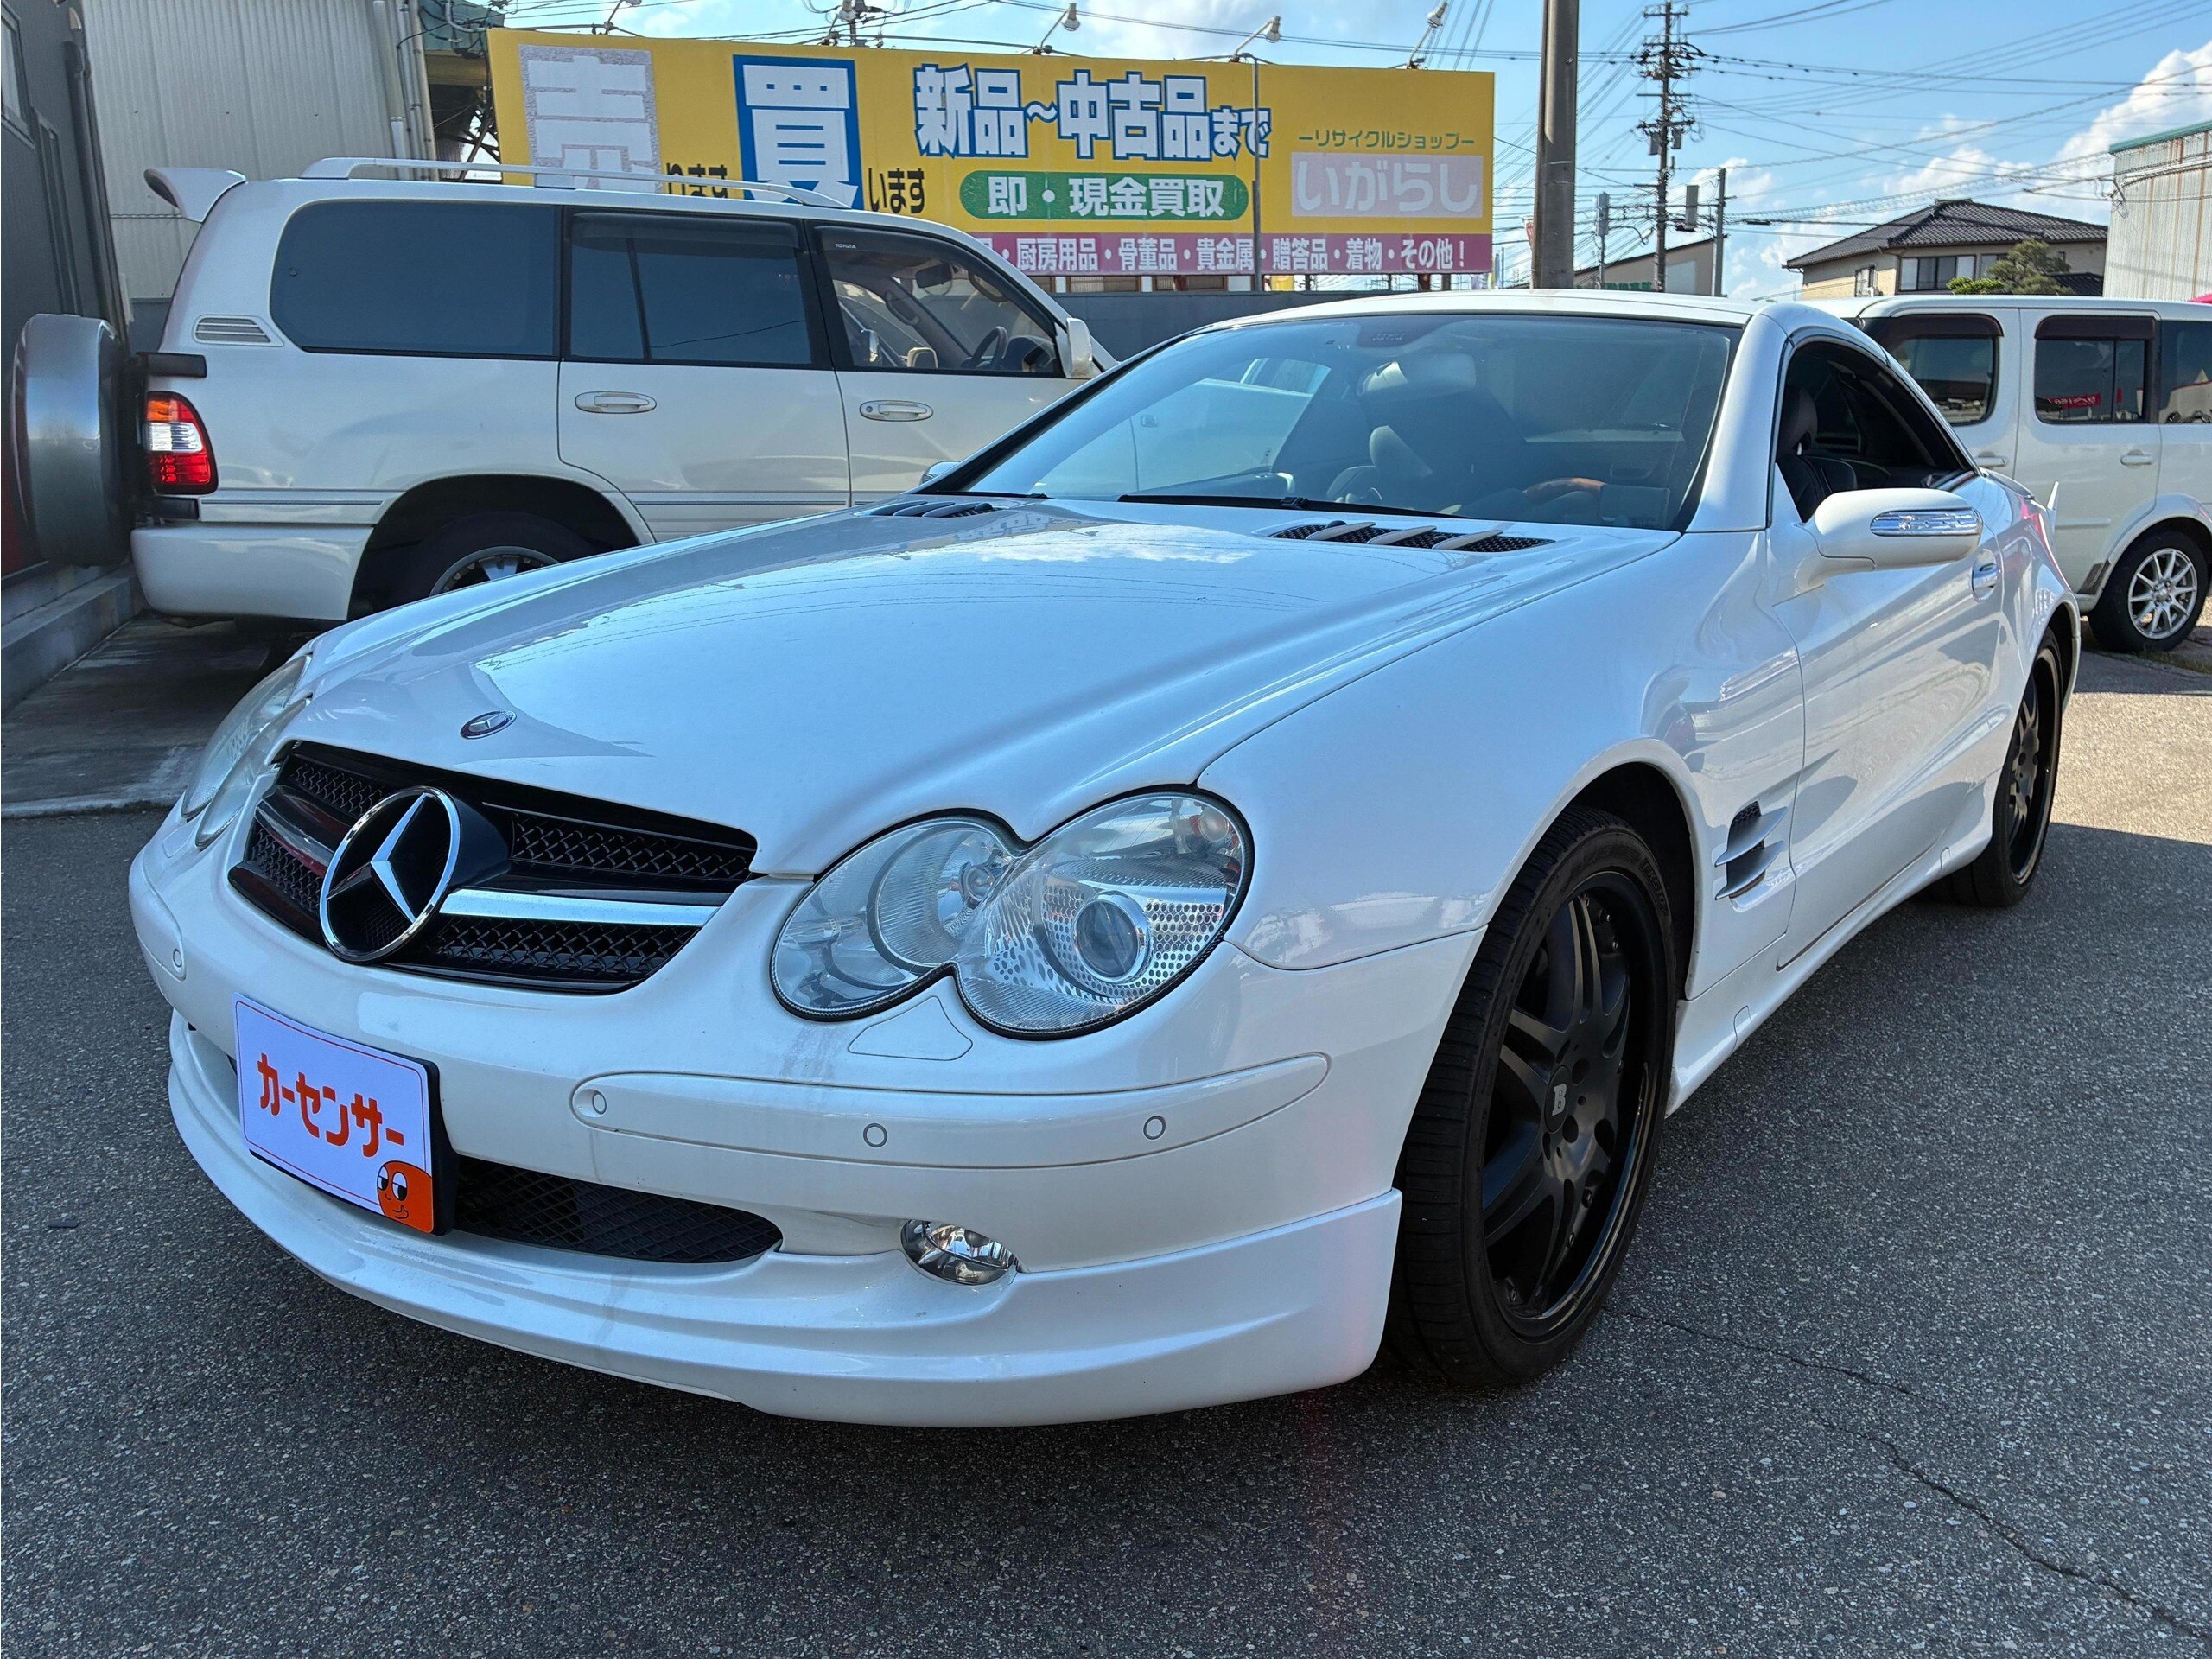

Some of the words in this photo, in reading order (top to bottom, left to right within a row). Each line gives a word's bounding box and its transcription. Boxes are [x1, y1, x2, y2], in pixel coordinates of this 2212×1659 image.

[987, 175, 1225, 218] 即・現金買取
[1298, 159, 1478, 213] いがらし
[257, 1052, 405, 1158] カーセンサー
[1552, 1083, 1567, 1116] B
